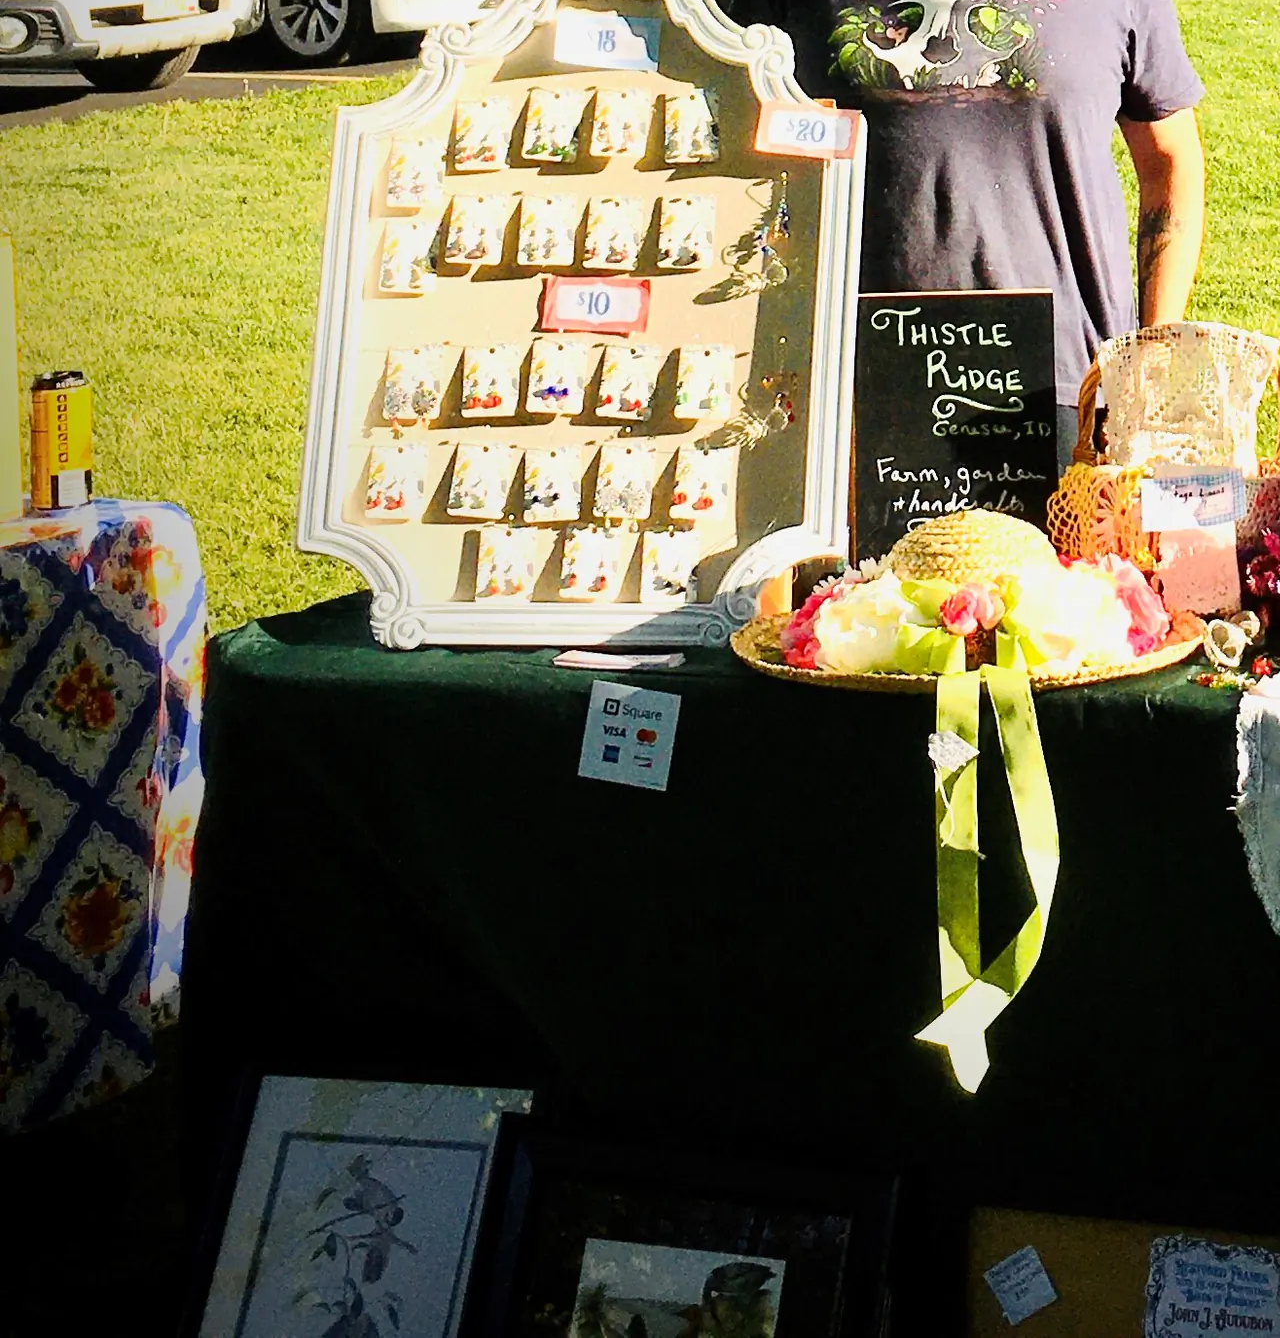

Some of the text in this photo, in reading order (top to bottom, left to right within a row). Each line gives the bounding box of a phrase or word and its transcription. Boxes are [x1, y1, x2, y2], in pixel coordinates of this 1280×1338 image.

[785, 118, 827, 143] $20
[577, 290, 611, 315] $10
[870, 306, 1013, 347] THISTLE
[1022, 420, 1052, 437] ID
[876, 457, 951, 489] Farm,
[622, 703, 662, 720] Square
[602, 724, 628, 739] VISA
[1164, 1302, 1200, 1327] JOHN
[1214, 1308, 1273, 1332] AUDUBON
